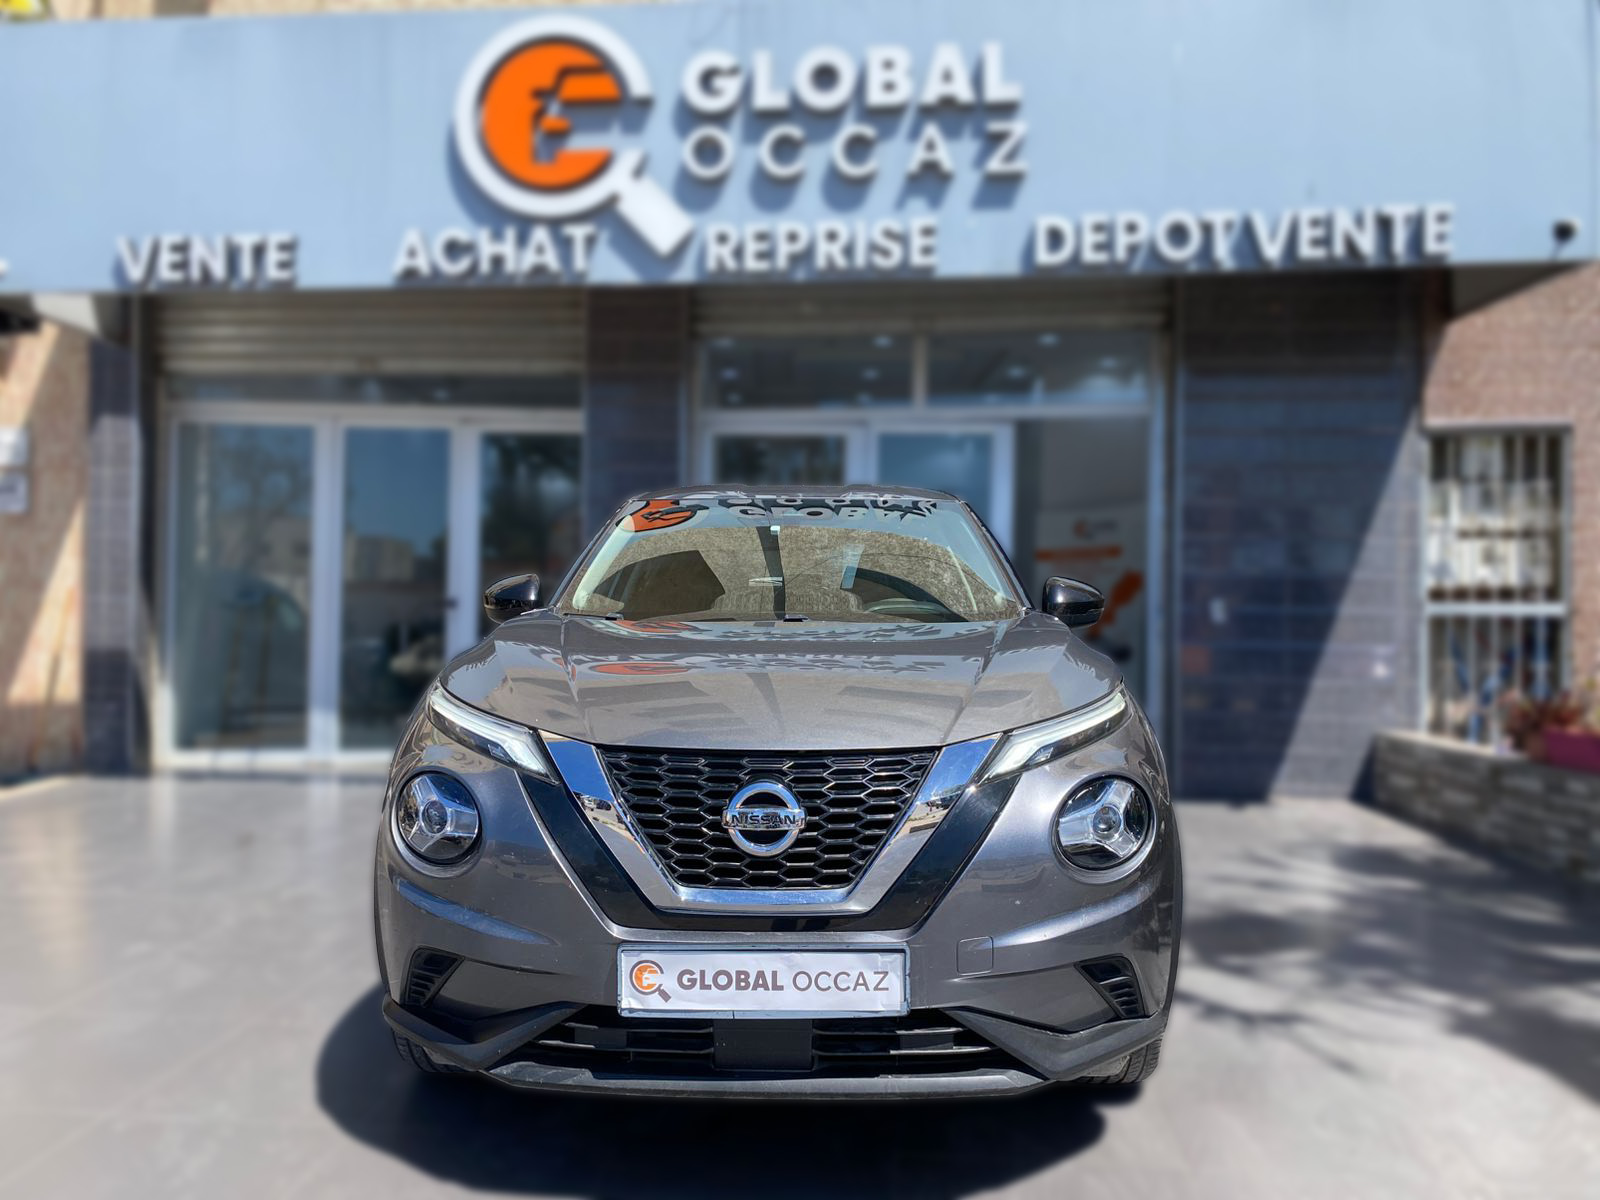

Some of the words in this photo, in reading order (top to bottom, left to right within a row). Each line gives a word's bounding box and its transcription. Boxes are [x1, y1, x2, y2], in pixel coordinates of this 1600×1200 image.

[684, 43, 1021, 112] GLOBAL
[684, 121, 1027, 178] OCCAZ
[118, 233, 297, 283] VENTE
[393, 223, 595, 278] ACHAT
[706, 220, 938, 272] REPRISE
[1035, 208, 1232, 268] DEPOT
[1248, 203, 1455, 260] VENTE
[731, 814, 796, 825] NISSAN
[677, 969, 784, 991] GLOBAL
[792, 970, 889, 992] OCCAZ
